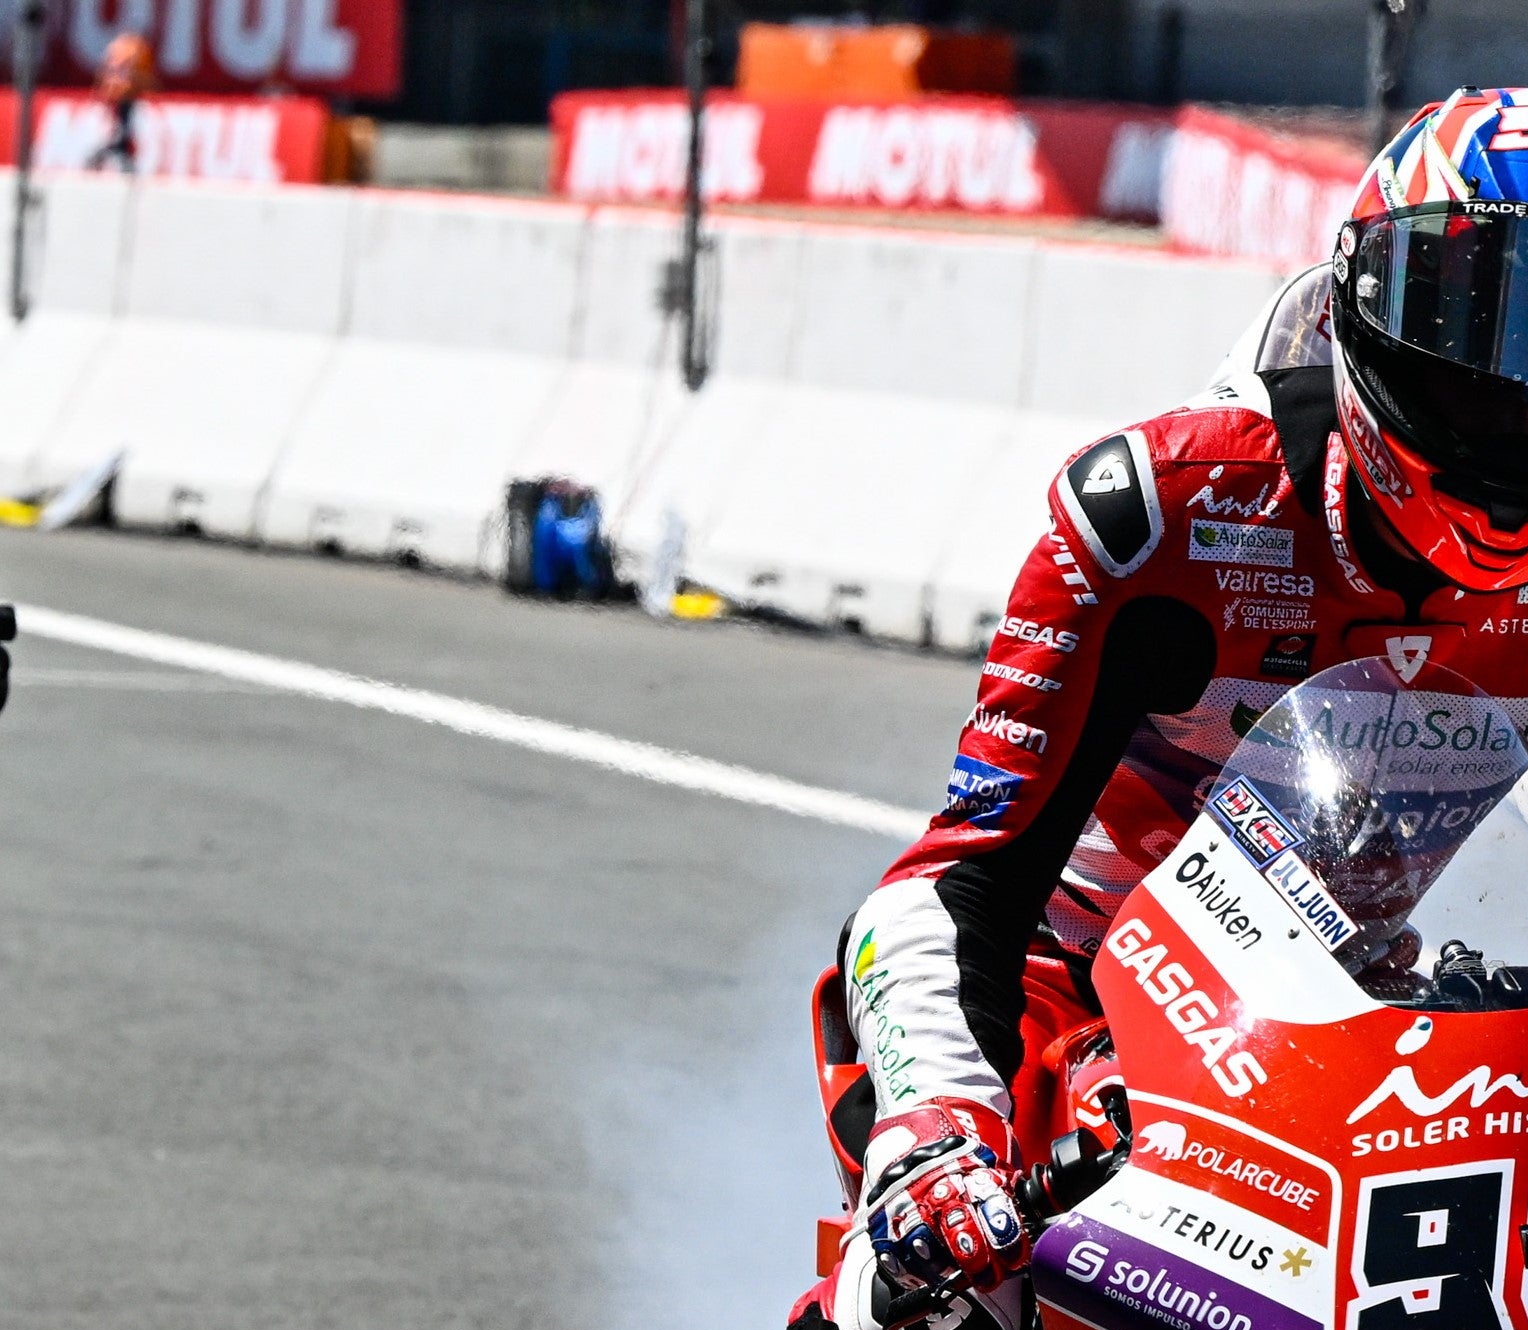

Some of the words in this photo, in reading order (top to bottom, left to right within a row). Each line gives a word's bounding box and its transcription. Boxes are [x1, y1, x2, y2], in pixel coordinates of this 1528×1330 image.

[808, 105, 1046, 208] MOTUL
[1462, 202, 1527, 216] TRADE
[1186, 464, 1283, 519] inde
[1218, 526, 1292, 551] AutoSolar
[1324, 461, 1375, 594] GASGAS
[1240, 605, 1309, 620] COMUNITAT
[1244, 617, 1261, 629] DE
[983, 661, 1063, 692] DUNLOP
[1387, 756, 1443, 775] solar
[1218, 783, 1296, 852] DIXON
[1287, 879, 1350, 946] J.JUAN
[1106, 917, 1268, 1098] GASGAS
[1351, 1116, 1470, 1157] SOLER
[1181, 1141, 1320, 1212] POLARCUBE
[1103, 1285, 1141, 1311] SOMOS
